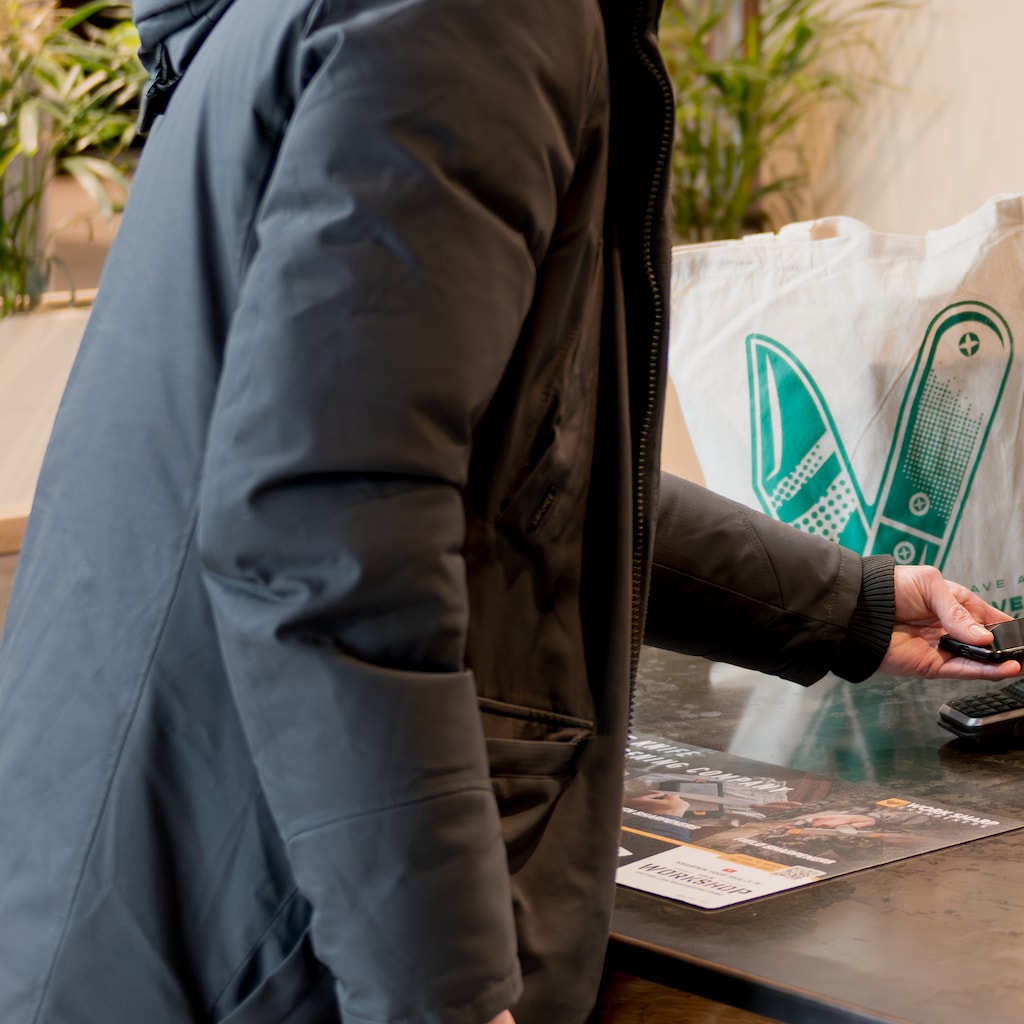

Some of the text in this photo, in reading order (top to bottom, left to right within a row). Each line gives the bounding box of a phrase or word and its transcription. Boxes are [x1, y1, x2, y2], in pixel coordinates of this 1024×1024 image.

[971, 580, 1005, 593] AVE
[629, 740, 702, 758] KNIFE
[625, 750, 795, 793] ENING COMPANY
[907, 802, 1000, 826] WORK SHARP
[637, 863, 753, 895] WORKSHOP
